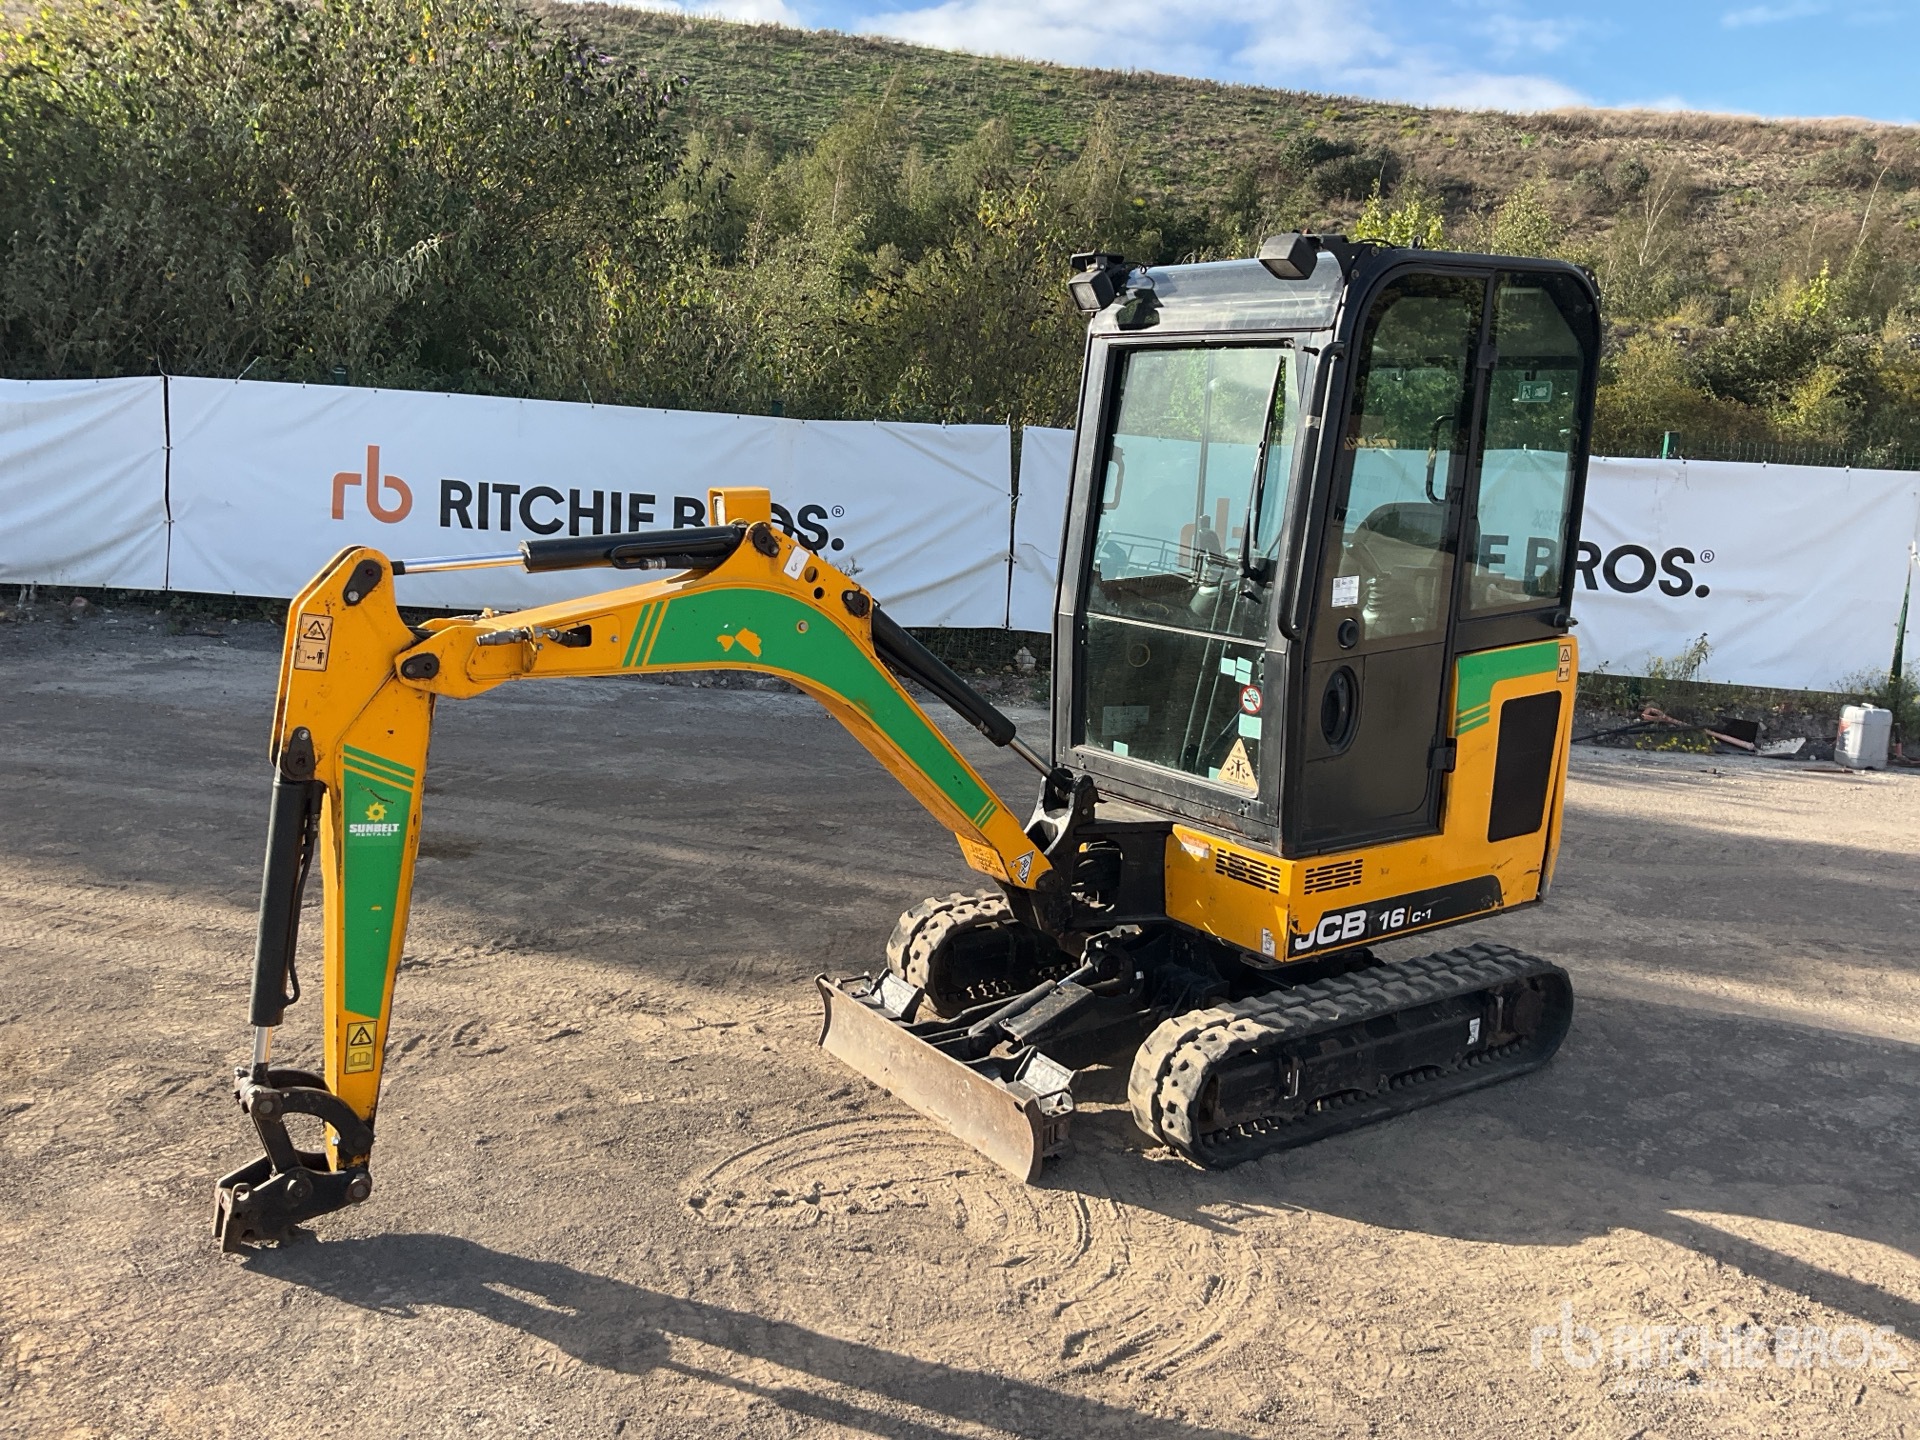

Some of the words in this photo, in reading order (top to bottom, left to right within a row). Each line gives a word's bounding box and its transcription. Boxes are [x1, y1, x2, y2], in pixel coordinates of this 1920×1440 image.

[331, 445, 413, 523] rb
[349, 823, 399, 832] SUNBELT
[1294, 909, 1367, 950] JCB
[1379, 907, 1406, 931] 16
